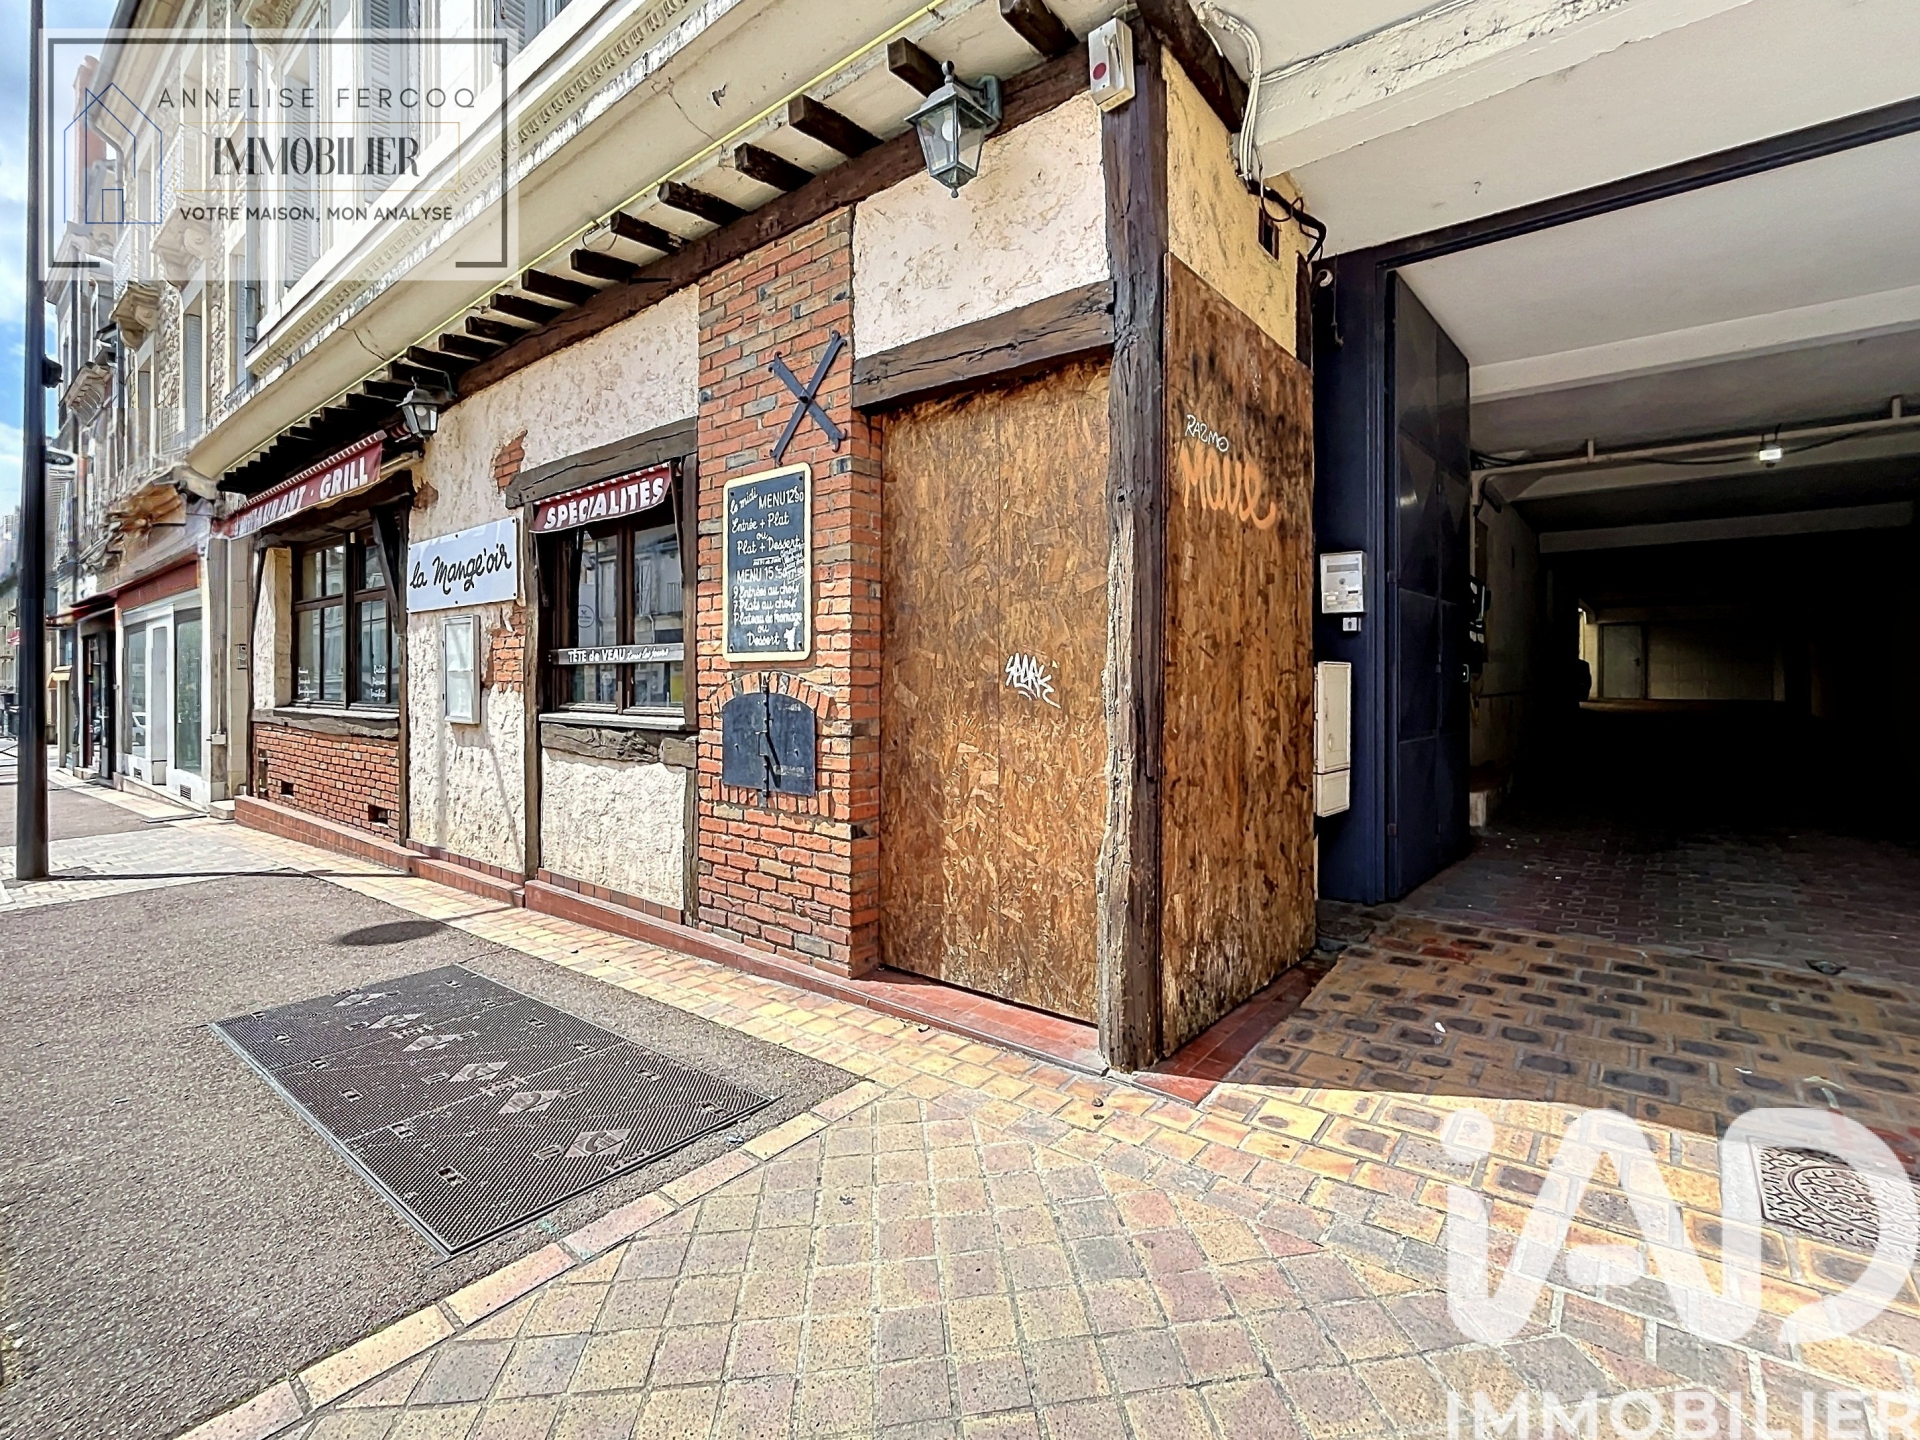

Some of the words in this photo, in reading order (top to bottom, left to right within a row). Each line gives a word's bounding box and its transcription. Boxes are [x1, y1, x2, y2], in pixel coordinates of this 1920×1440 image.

[319, 456, 368, 500] GRILL
[543, 478, 664, 529] SPÉCIALITÉS
[759, 491, 786, 510] MENU
[768, 511, 790, 528] Plat
[737, 539, 757, 555] Plat
[737, 567, 762, 584] MENU
[589, 650, 600, 661] de
[602, 649, 626, 661] VEAU
